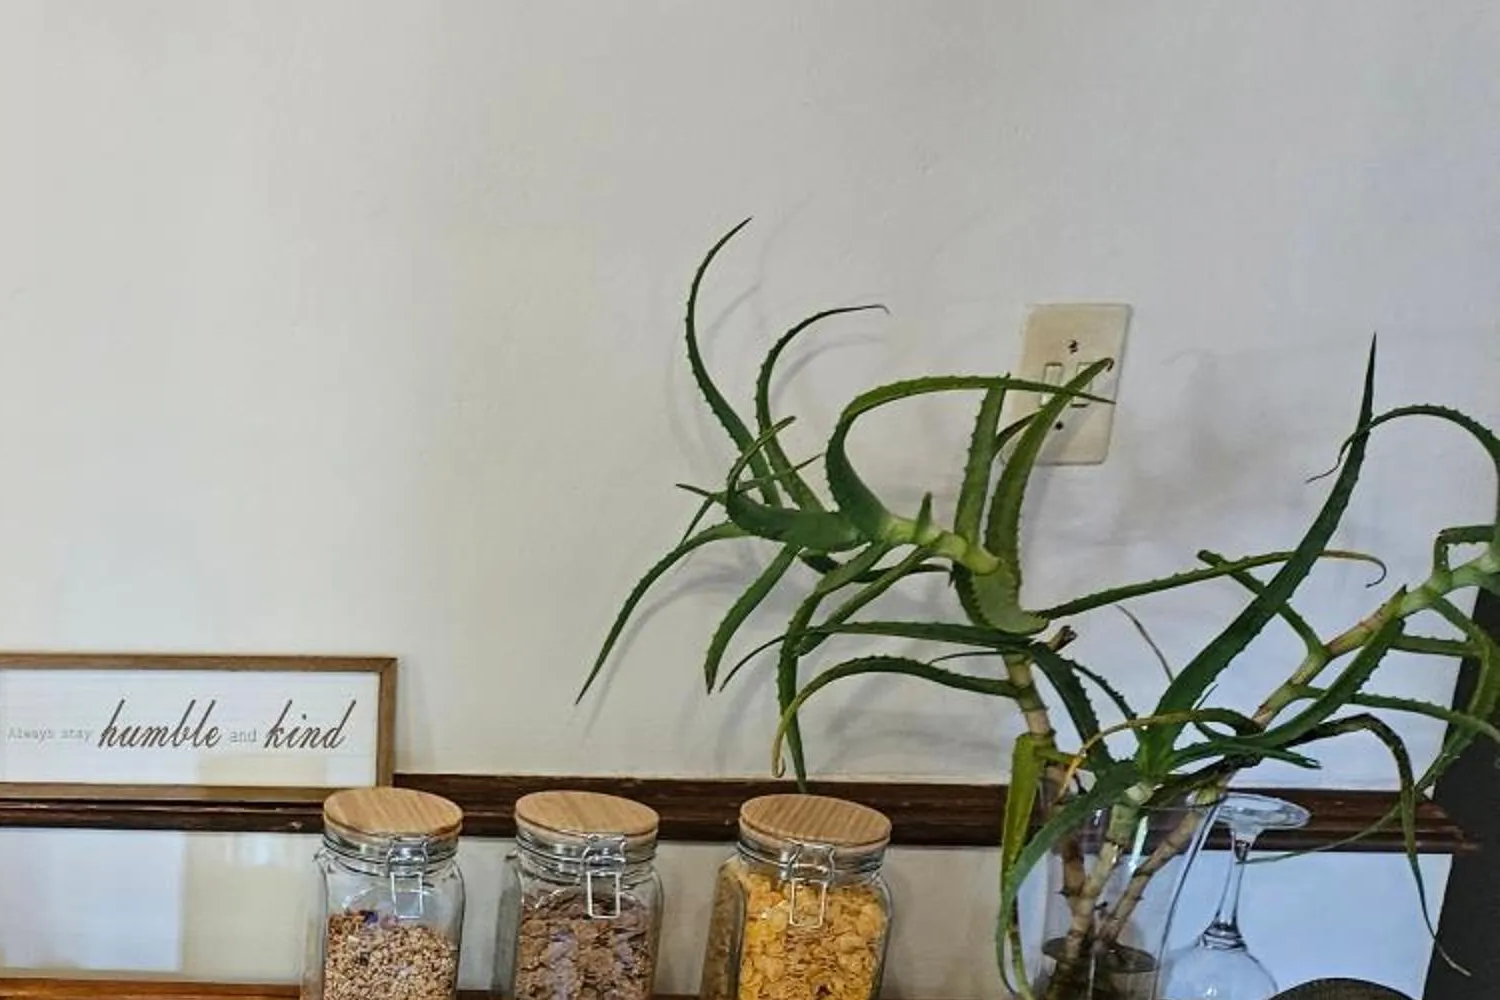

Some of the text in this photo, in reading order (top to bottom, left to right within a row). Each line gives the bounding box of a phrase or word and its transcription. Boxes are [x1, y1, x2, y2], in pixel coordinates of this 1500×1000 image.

[7, 699, 356, 749] Always stay humble and kind
